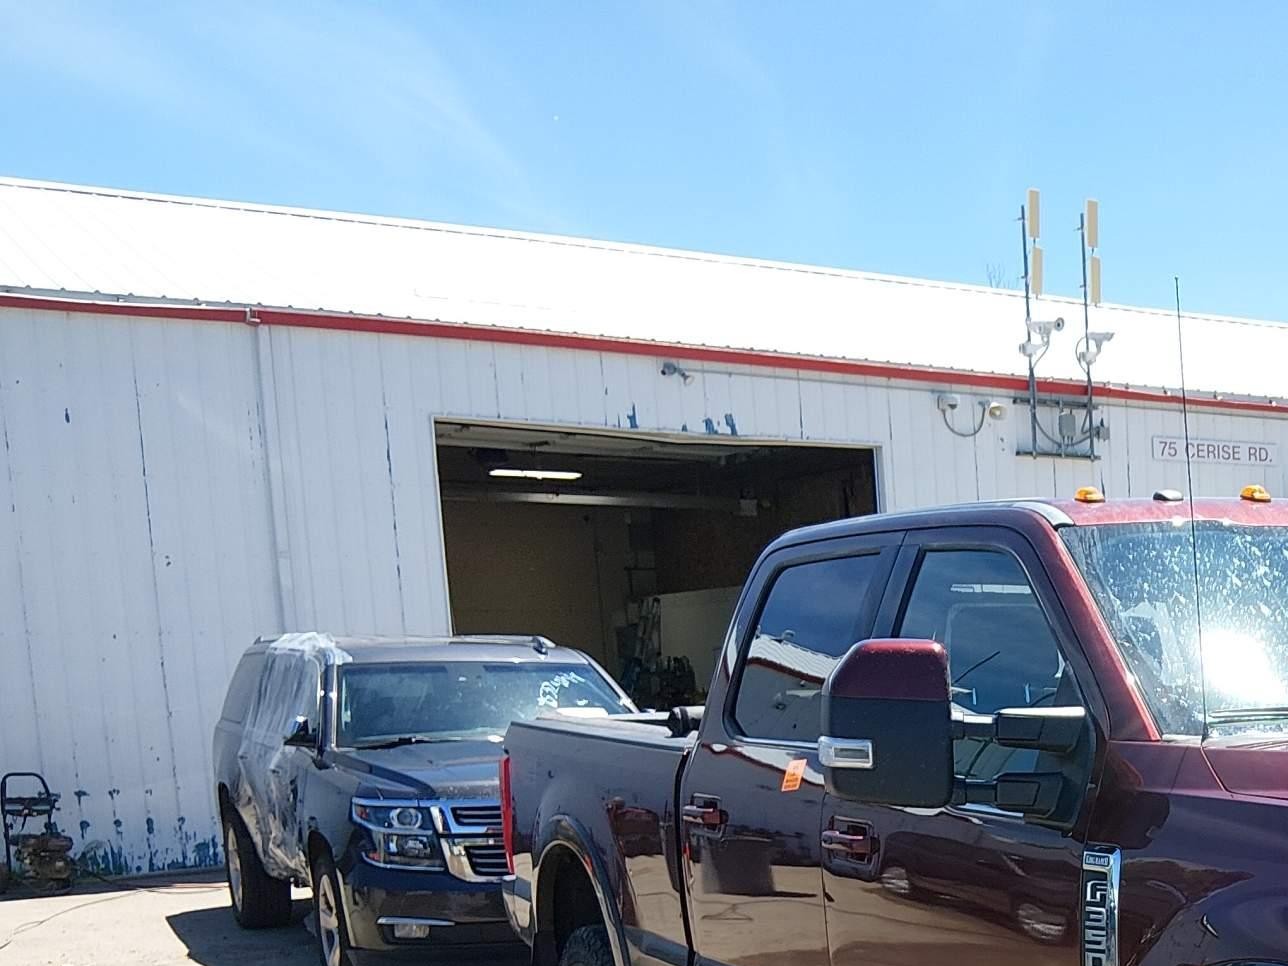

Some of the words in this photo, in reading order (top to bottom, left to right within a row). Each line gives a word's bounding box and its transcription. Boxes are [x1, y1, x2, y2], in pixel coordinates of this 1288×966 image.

[1158, 440, 1178, 457] 75
[1185, 442, 1241, 461] CERISE
[1248, 447, 1273, 463] RD.
